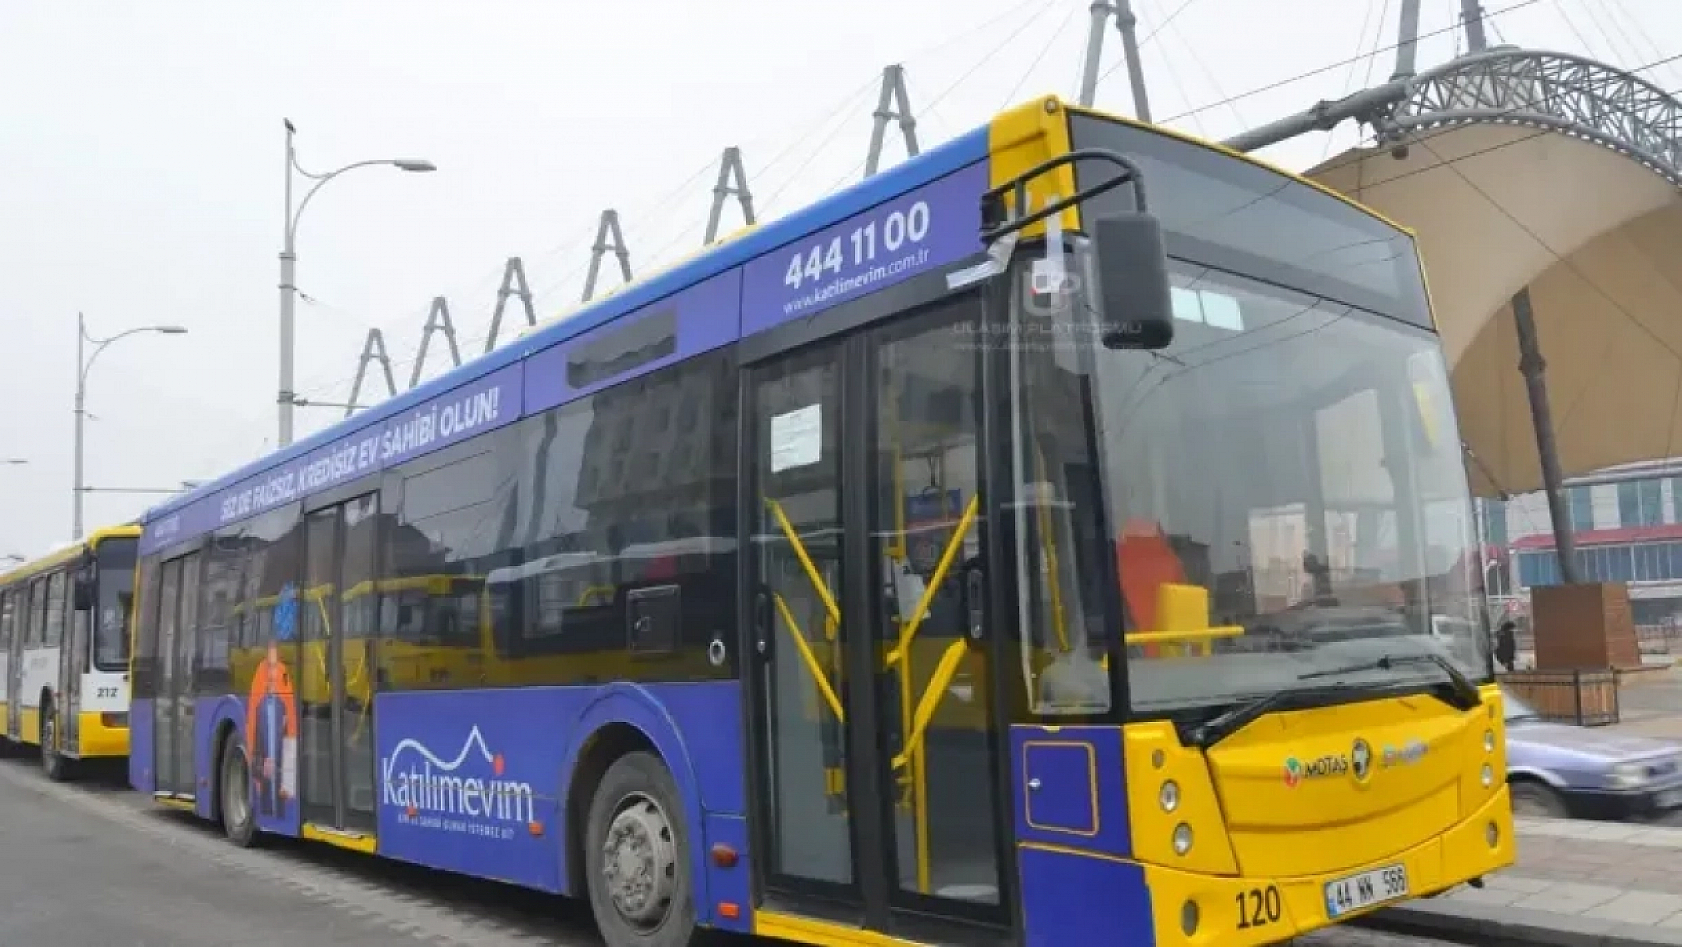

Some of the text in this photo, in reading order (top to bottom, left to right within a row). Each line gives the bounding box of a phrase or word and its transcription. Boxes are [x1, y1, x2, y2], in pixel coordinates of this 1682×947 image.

[785, 201, 930, 290] 444 11 00
[358, 436, 379, 470] EV
[380, 403, 438, 459] SAHİBİ
[440, 386, 499, 437] OLUN!
[97, 686, 119, 698] 212
[1235, 884, 1281, 929] 120
[1336, 881, 1353, 908] 44
